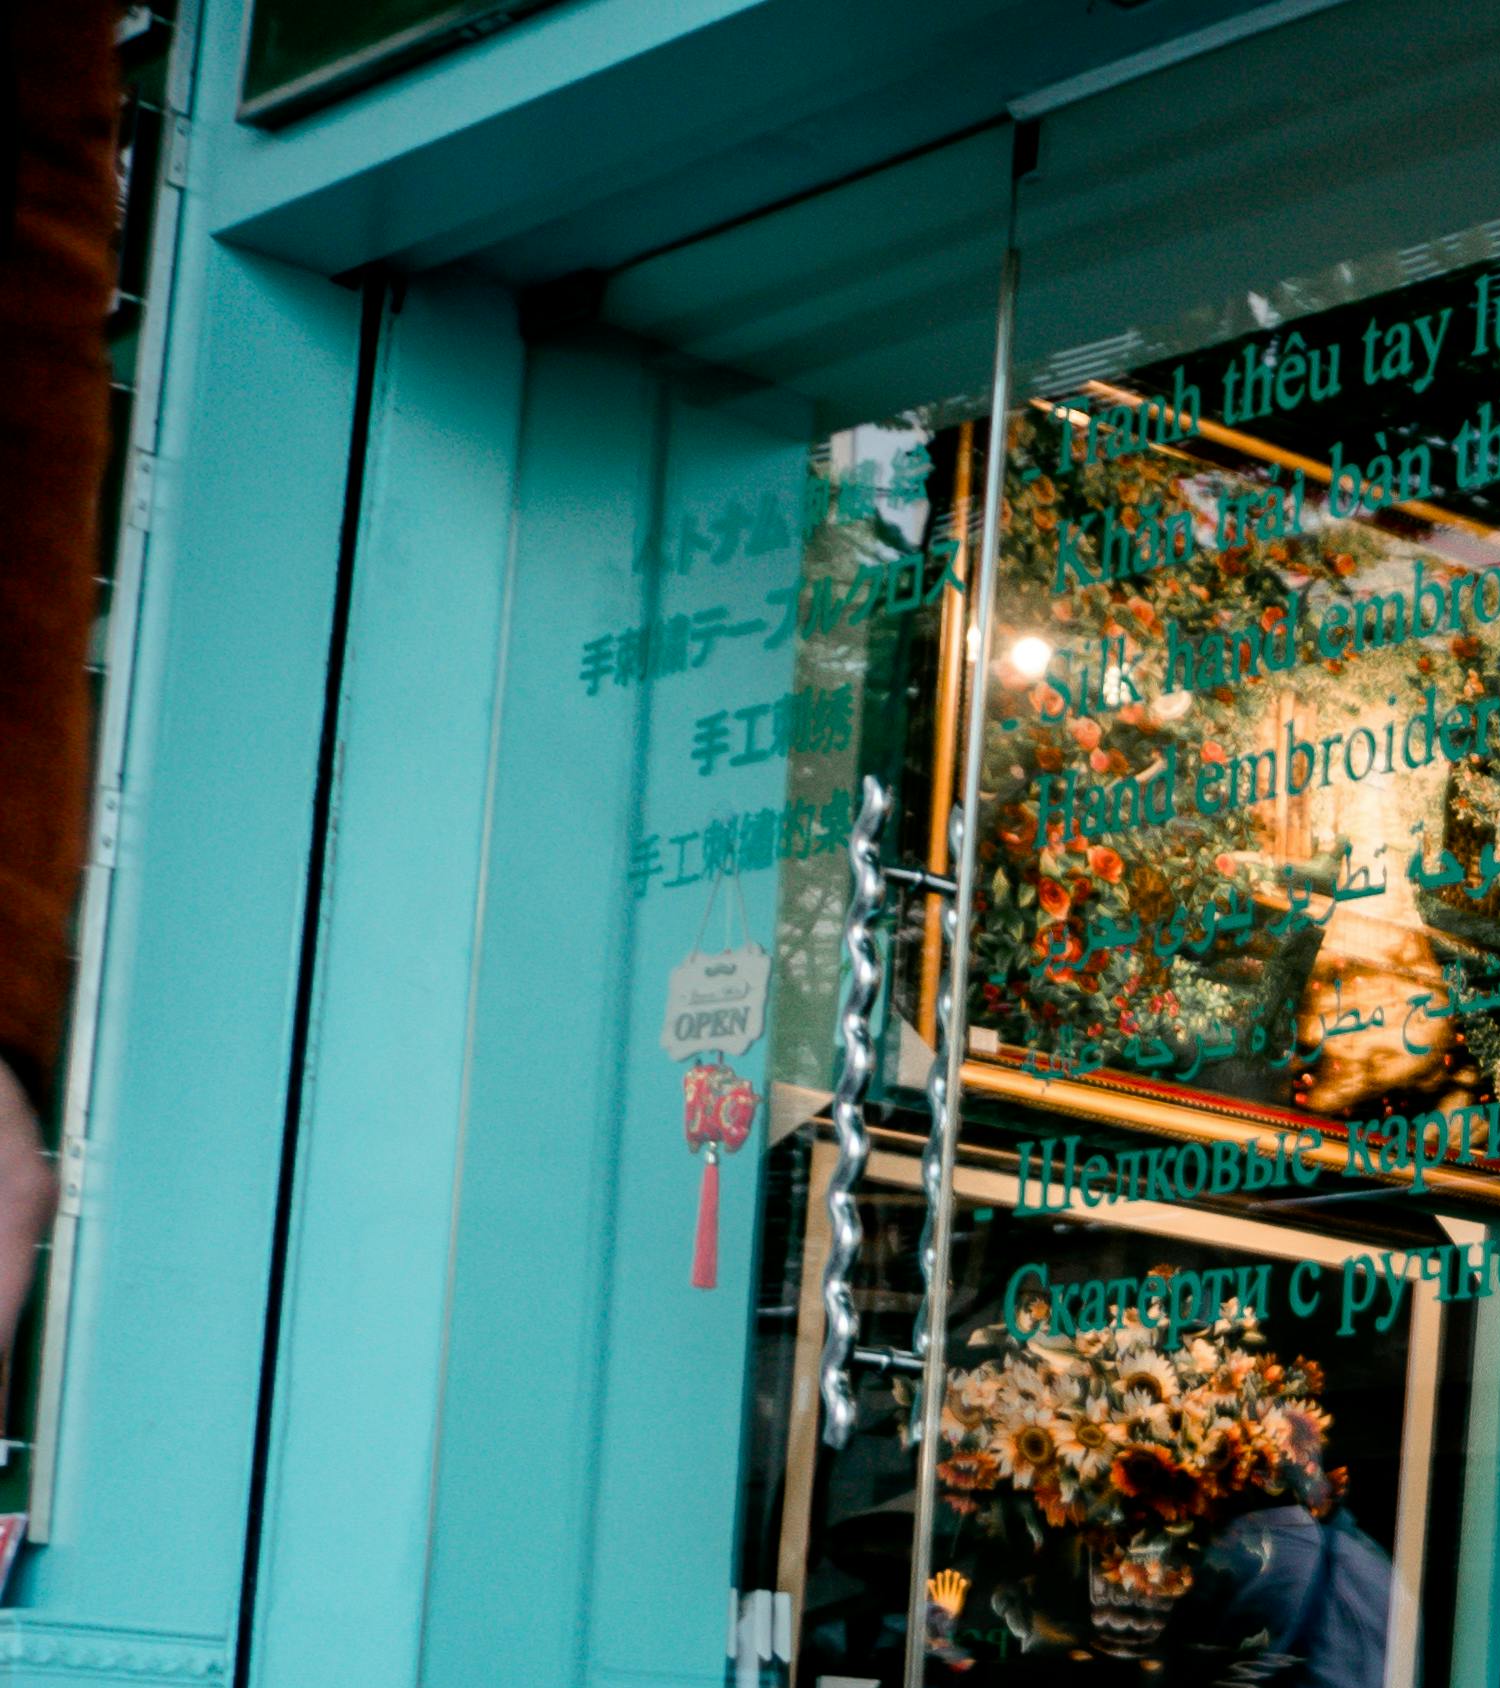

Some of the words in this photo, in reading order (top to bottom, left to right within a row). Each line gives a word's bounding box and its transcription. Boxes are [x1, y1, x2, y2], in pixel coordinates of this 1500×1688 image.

[1053, 368, 1200, 475] Tranh
[1221, 330, 1341, 426] thêu
[1361, 305, 1454, 396] tay
[1051, 490, 1195, 598] Khăn
[1329, 433, 1433, 521] bàn
[1037, 640, 1141, 723] Silk
[1164, 588, 1303, 696] hand
[1033, 744, 1178, 850] Hand
[674, 1004, 751, 1043] OPEN
[1013, 1127, 1322, 1218] Шелковые
[1001, 1260, 1273, 1351] Скатерти
[1289, 1256, 1321, 1320] с
